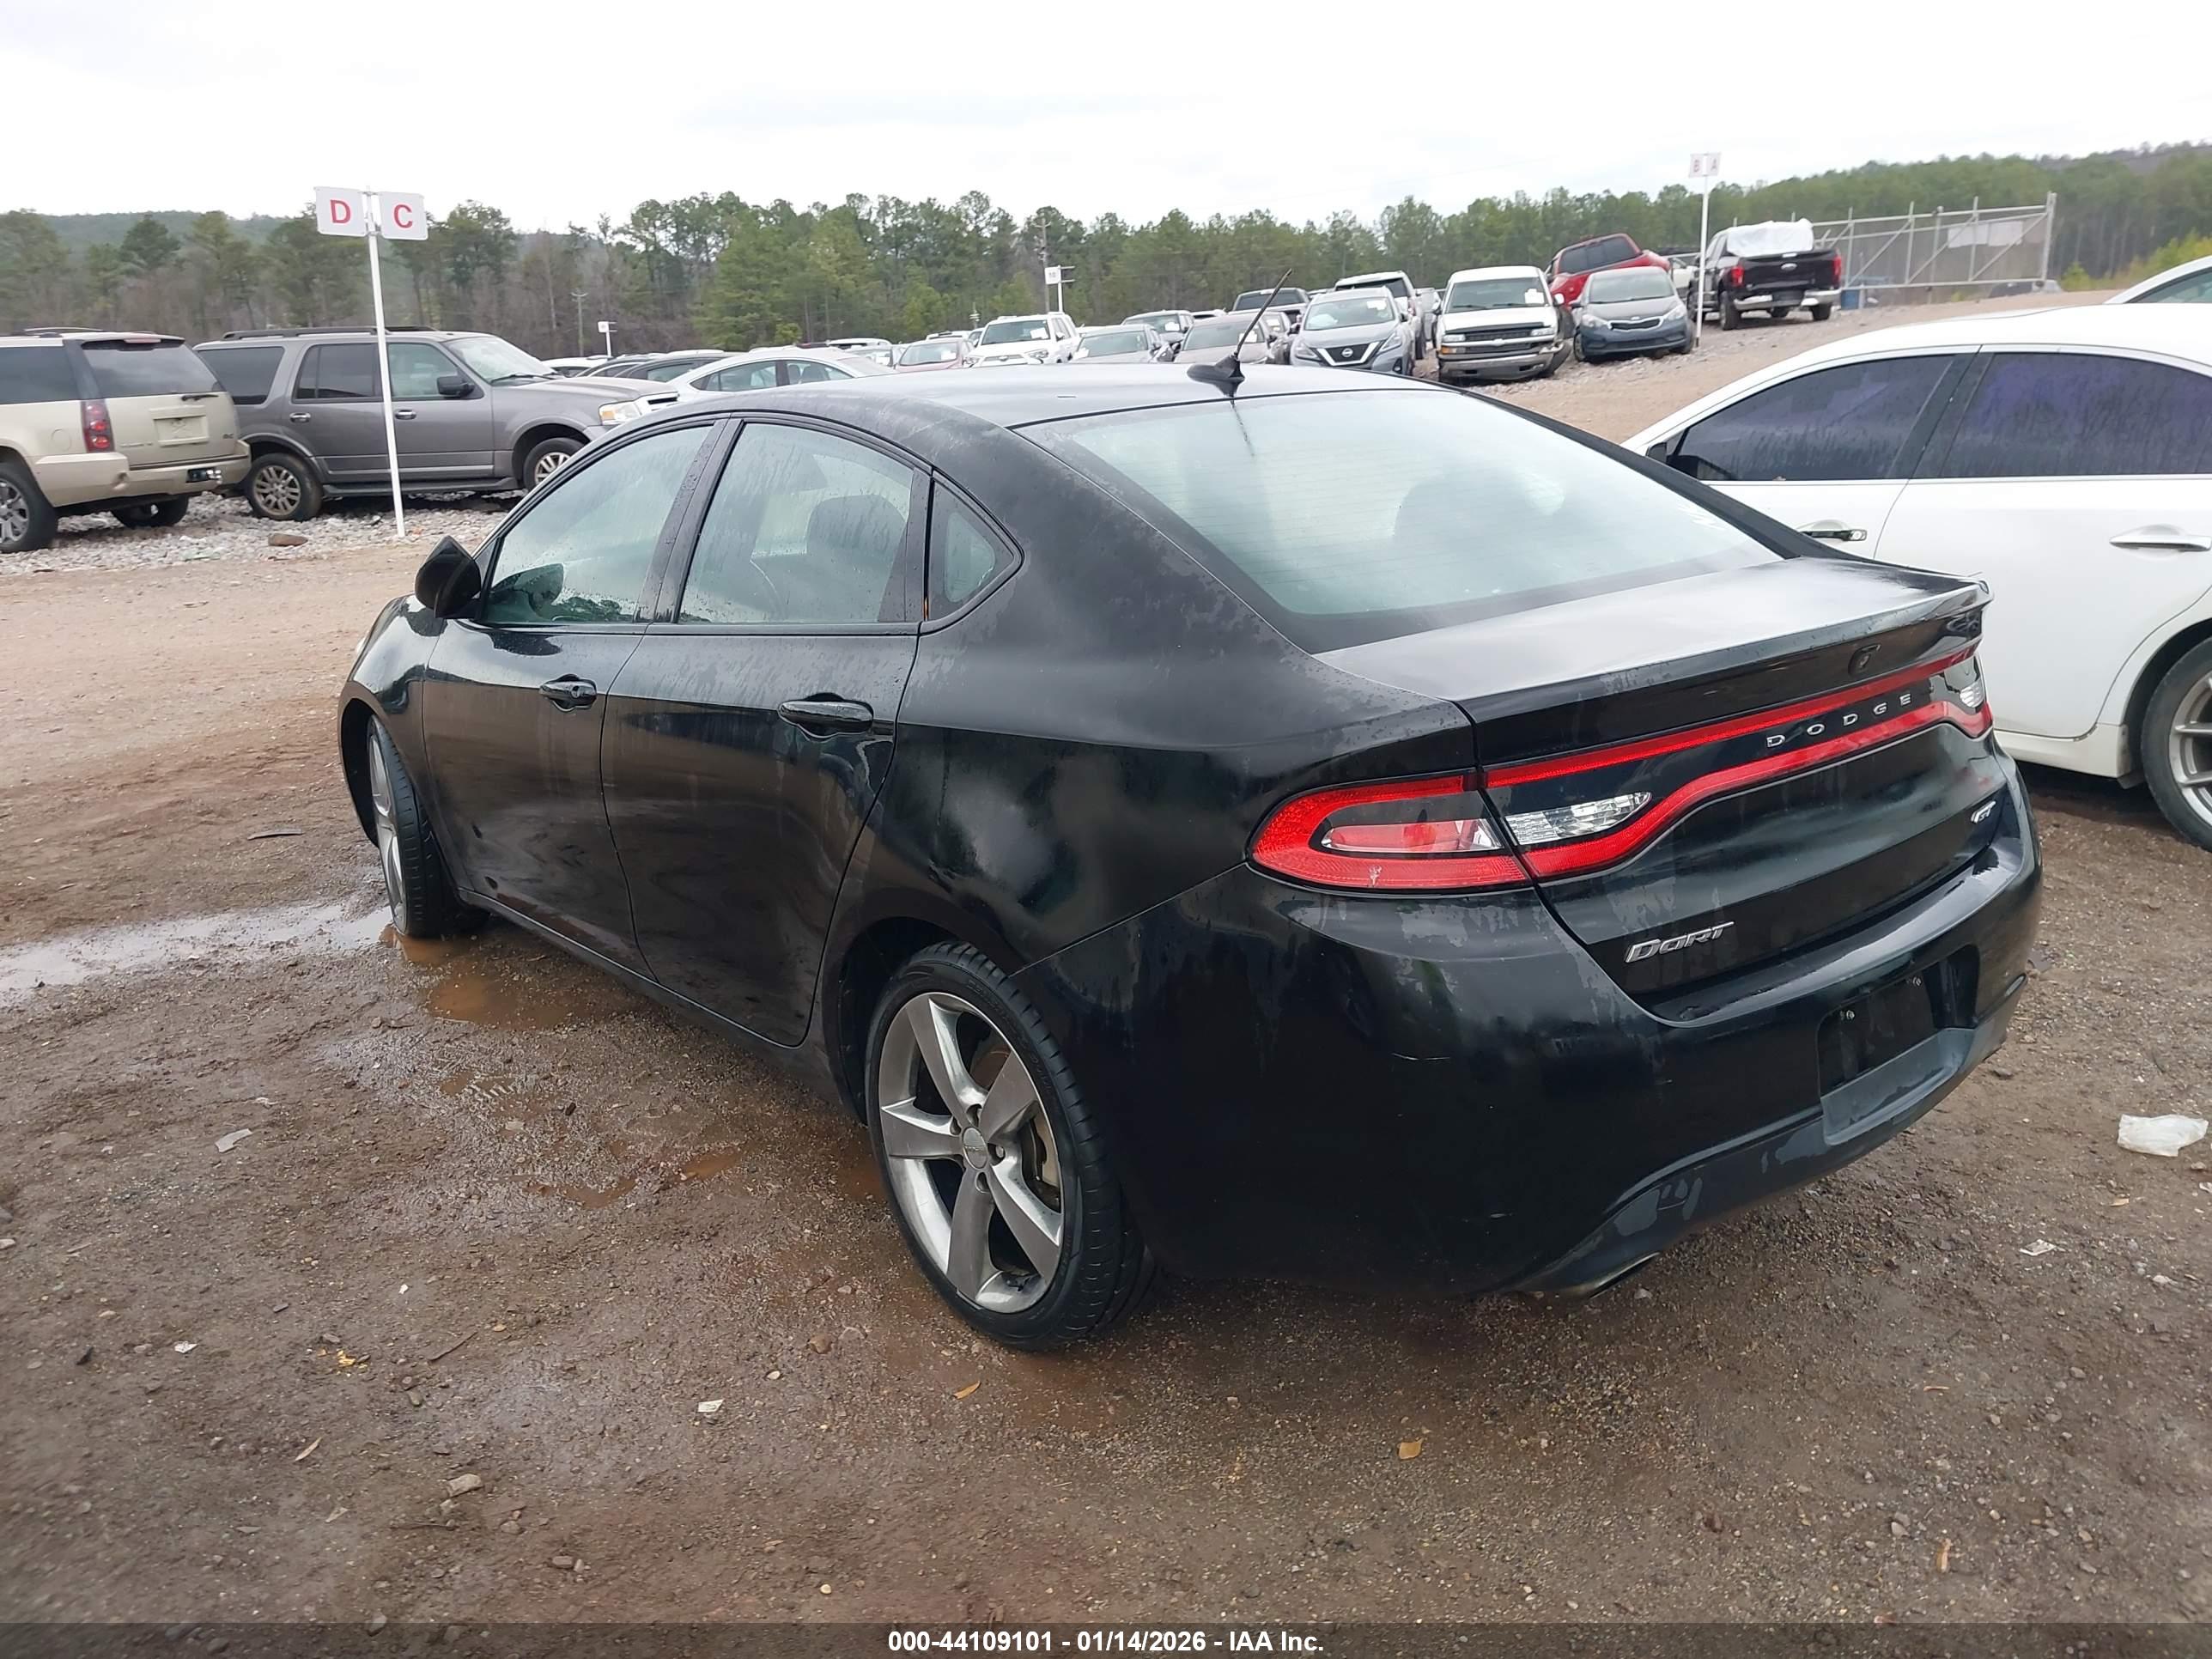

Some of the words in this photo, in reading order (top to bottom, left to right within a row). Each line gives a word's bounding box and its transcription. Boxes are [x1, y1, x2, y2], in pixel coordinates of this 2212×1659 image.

[330, 199, 351, 224] D
[393, 204, 413, 229] C
[1766, 693, 1911, 747] DODGE
[1971, 800, 1996, 823] GT
